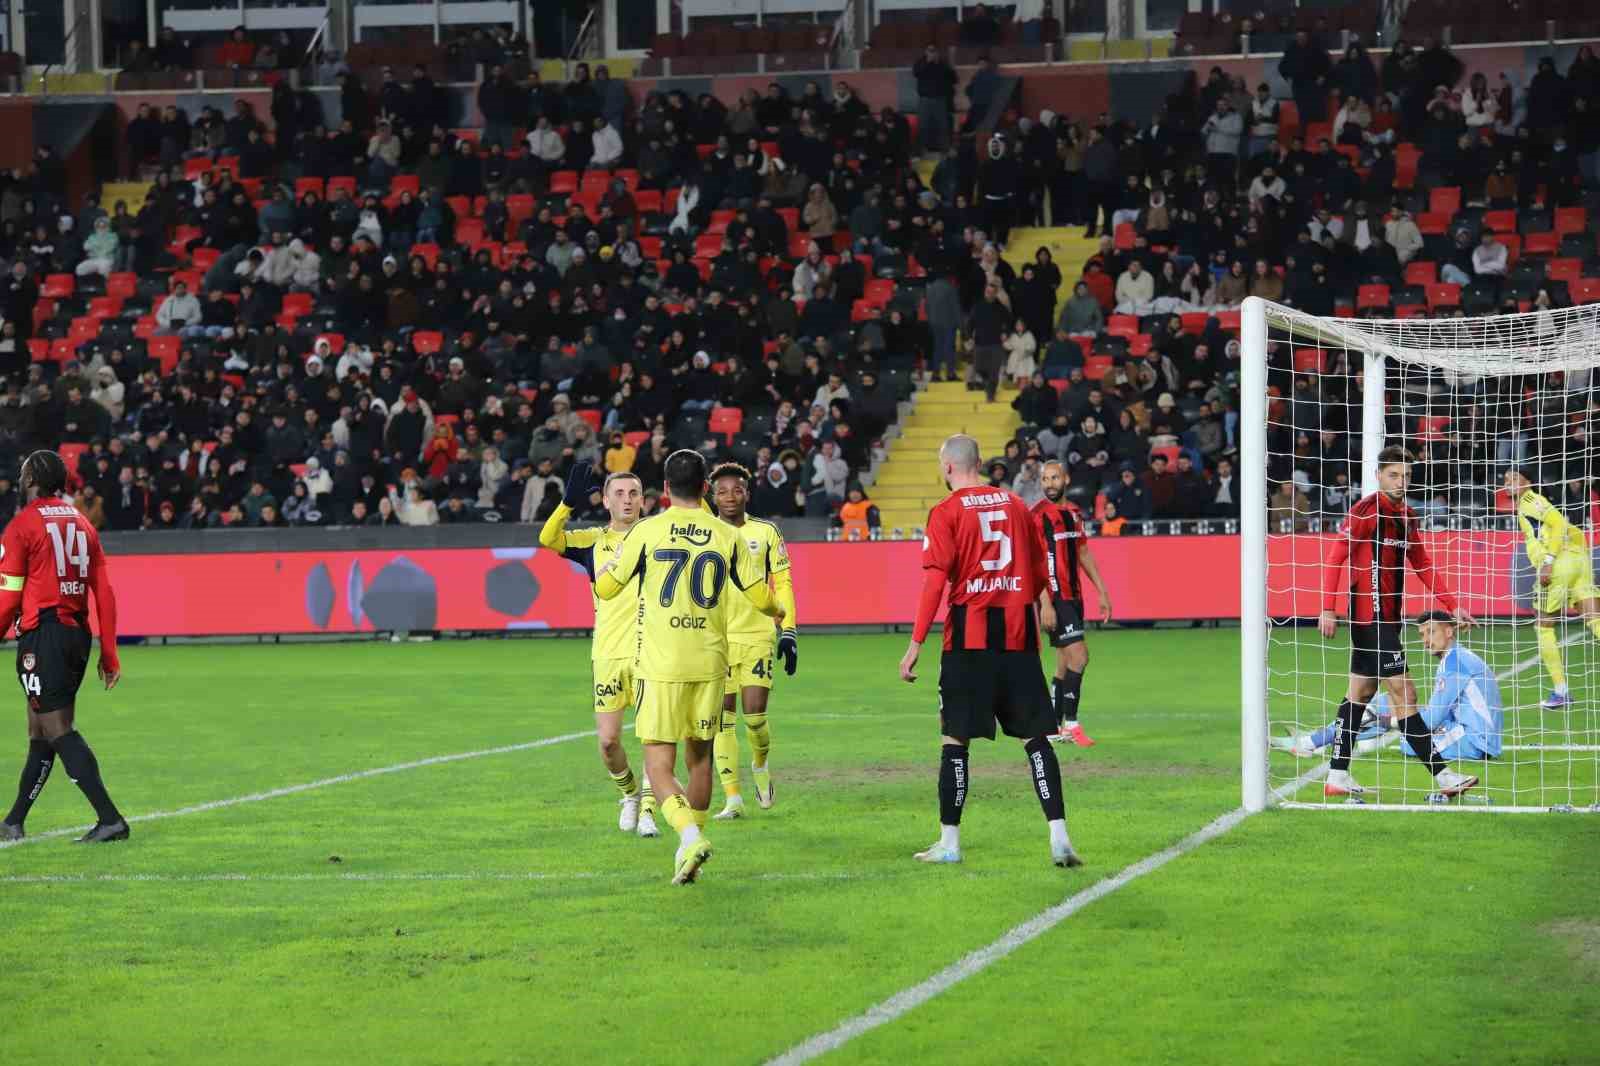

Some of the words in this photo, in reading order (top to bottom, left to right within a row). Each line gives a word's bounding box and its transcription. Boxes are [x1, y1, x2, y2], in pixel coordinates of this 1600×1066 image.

[669, 523, 713, 546] halley
[977, 510, 1013, 571] 5
[45, 522, 90, 578] 14
[653, 548, 727, 609] 70
[669, 613, 707, 629] OĞUZ
[751, 658, 774, 680] 45
[21, 673, 42, 696] 14
